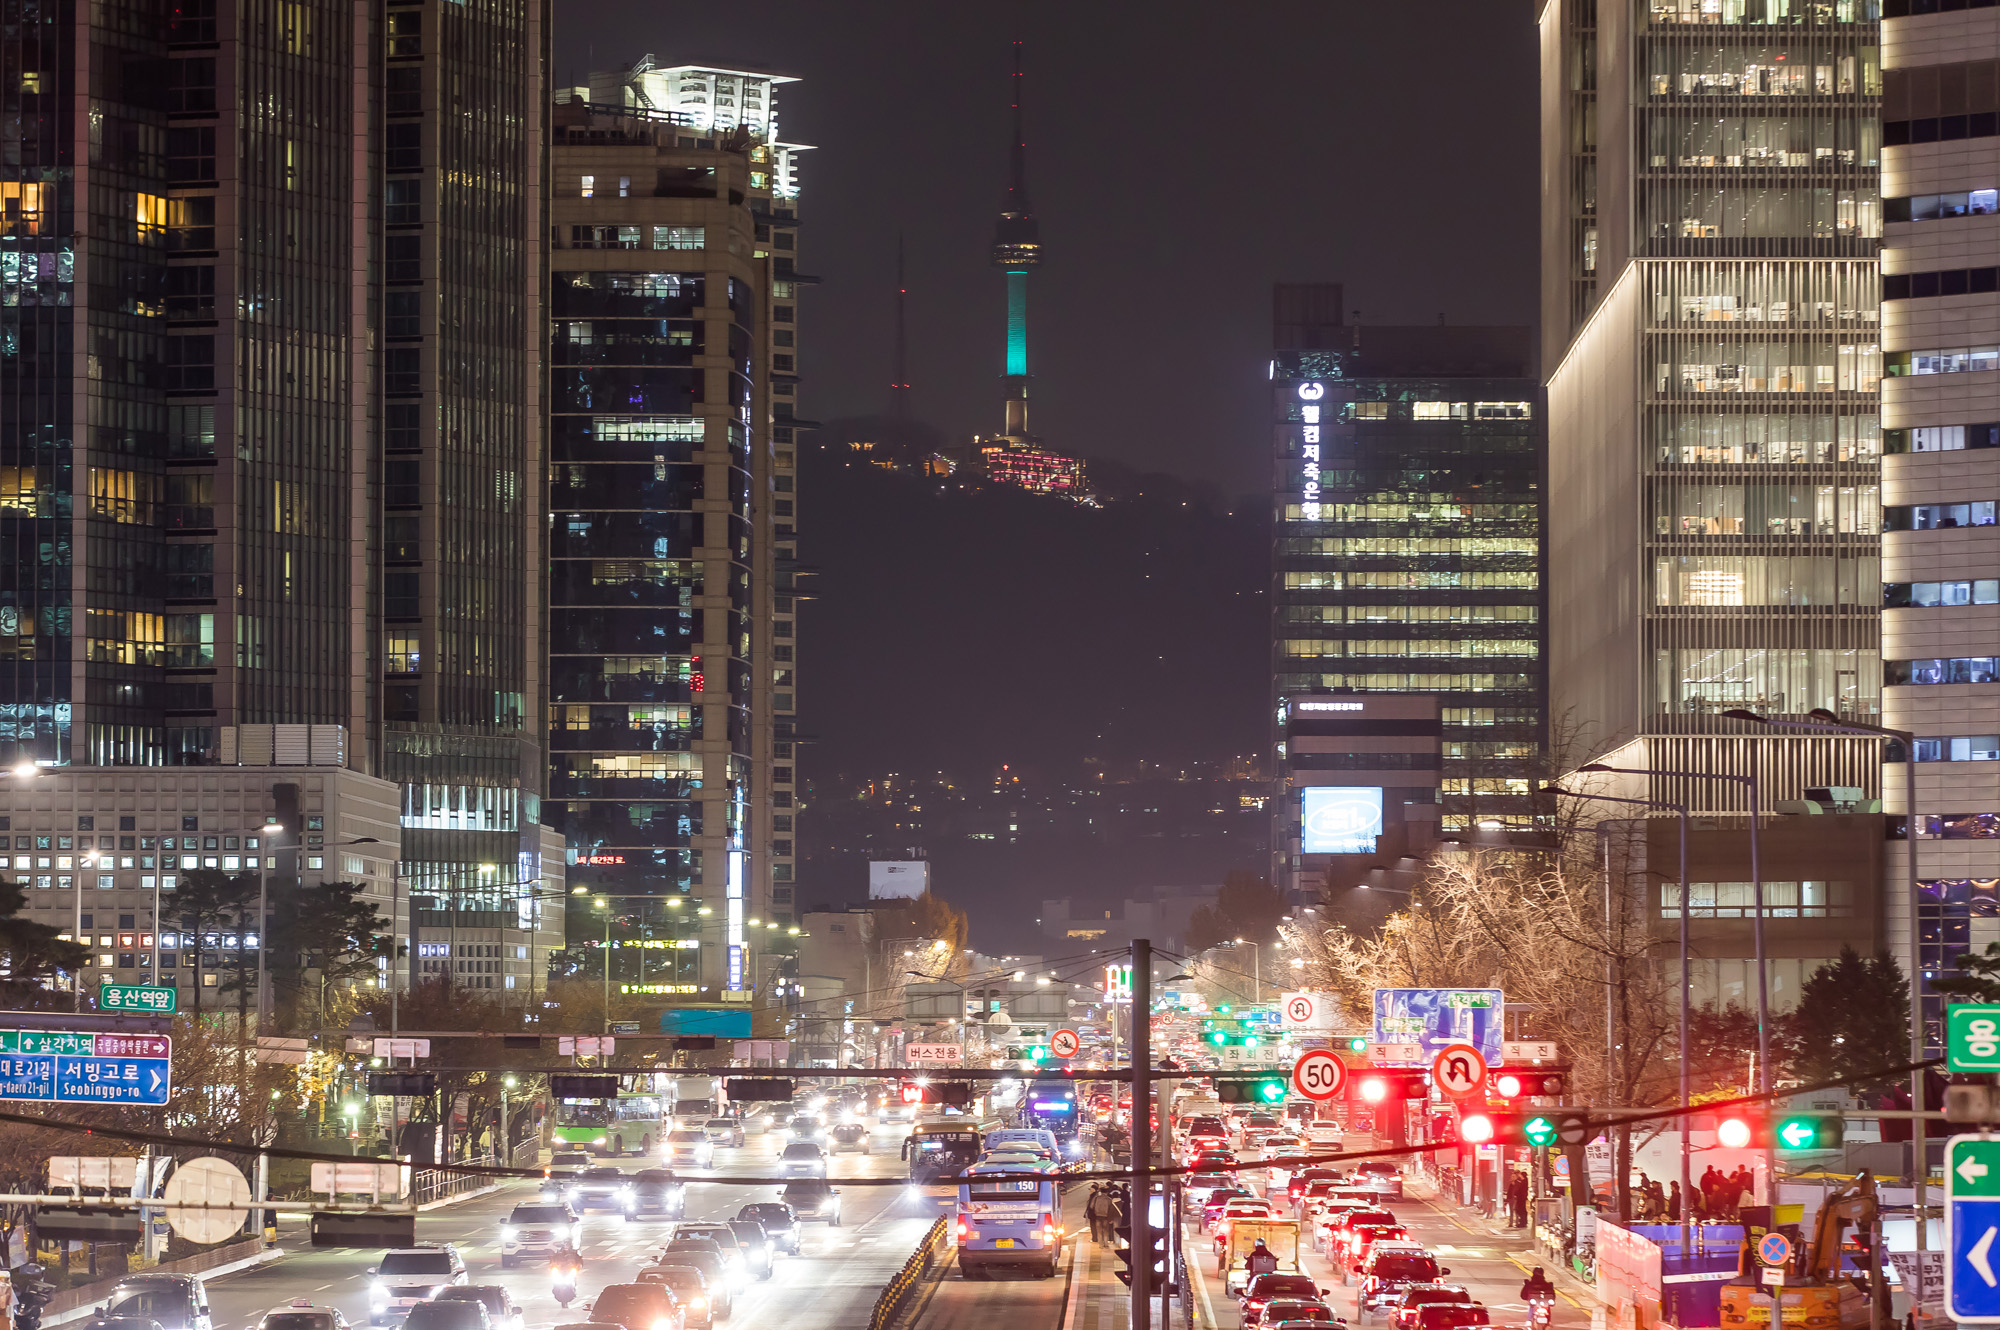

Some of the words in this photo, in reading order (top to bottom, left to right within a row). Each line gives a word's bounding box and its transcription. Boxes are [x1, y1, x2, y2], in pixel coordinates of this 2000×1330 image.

[1302, 405, 1320, 521] 웰컴저축은행
[107, 988, 170, 1009] 용산역앞
[39, 1037, 93, 1053] 삼각지역
[1964, 1019, 2000, 1057] 용
[98, 1039, 150, 1055] 국립중앙박물관
[910, 1046, 958, 1060] 버스전용
[65, 1062, 140, 1083] 서빙고로
[1307, 1063, 1335, 1088] 50
[28, 1081, 50, 1097] 21-gil
[63, 1082, 140, 1099] Seobinggo-ro
[1017, 1181, 1034, 1191] 150
